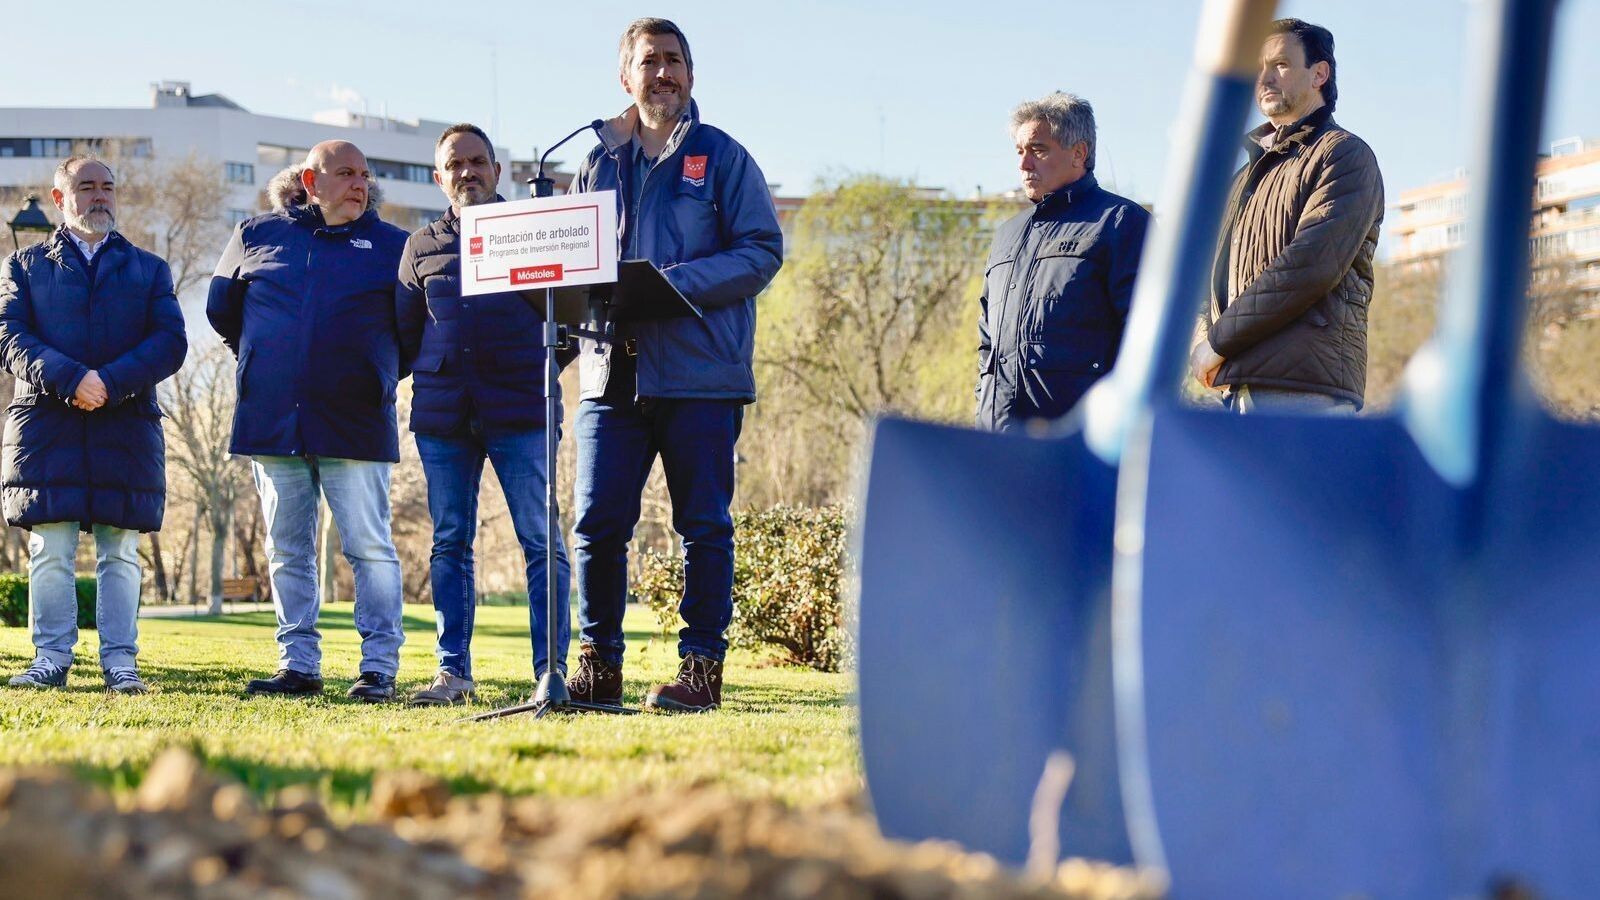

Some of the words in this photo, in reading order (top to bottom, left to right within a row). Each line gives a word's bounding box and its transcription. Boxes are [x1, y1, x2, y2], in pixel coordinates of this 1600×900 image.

[489, 230, 533, 246] Plantación
[535, 229, 547, 240] de
[549, 225, 589, 239] arbolado
[489, 248, 519, 258] Programa
[520, 246, 529, 255] de
[529, 243, 559, 254] Inversión
[561, 240, 590, 251] Regional
[517, 269, 556, 281] Móstoles
